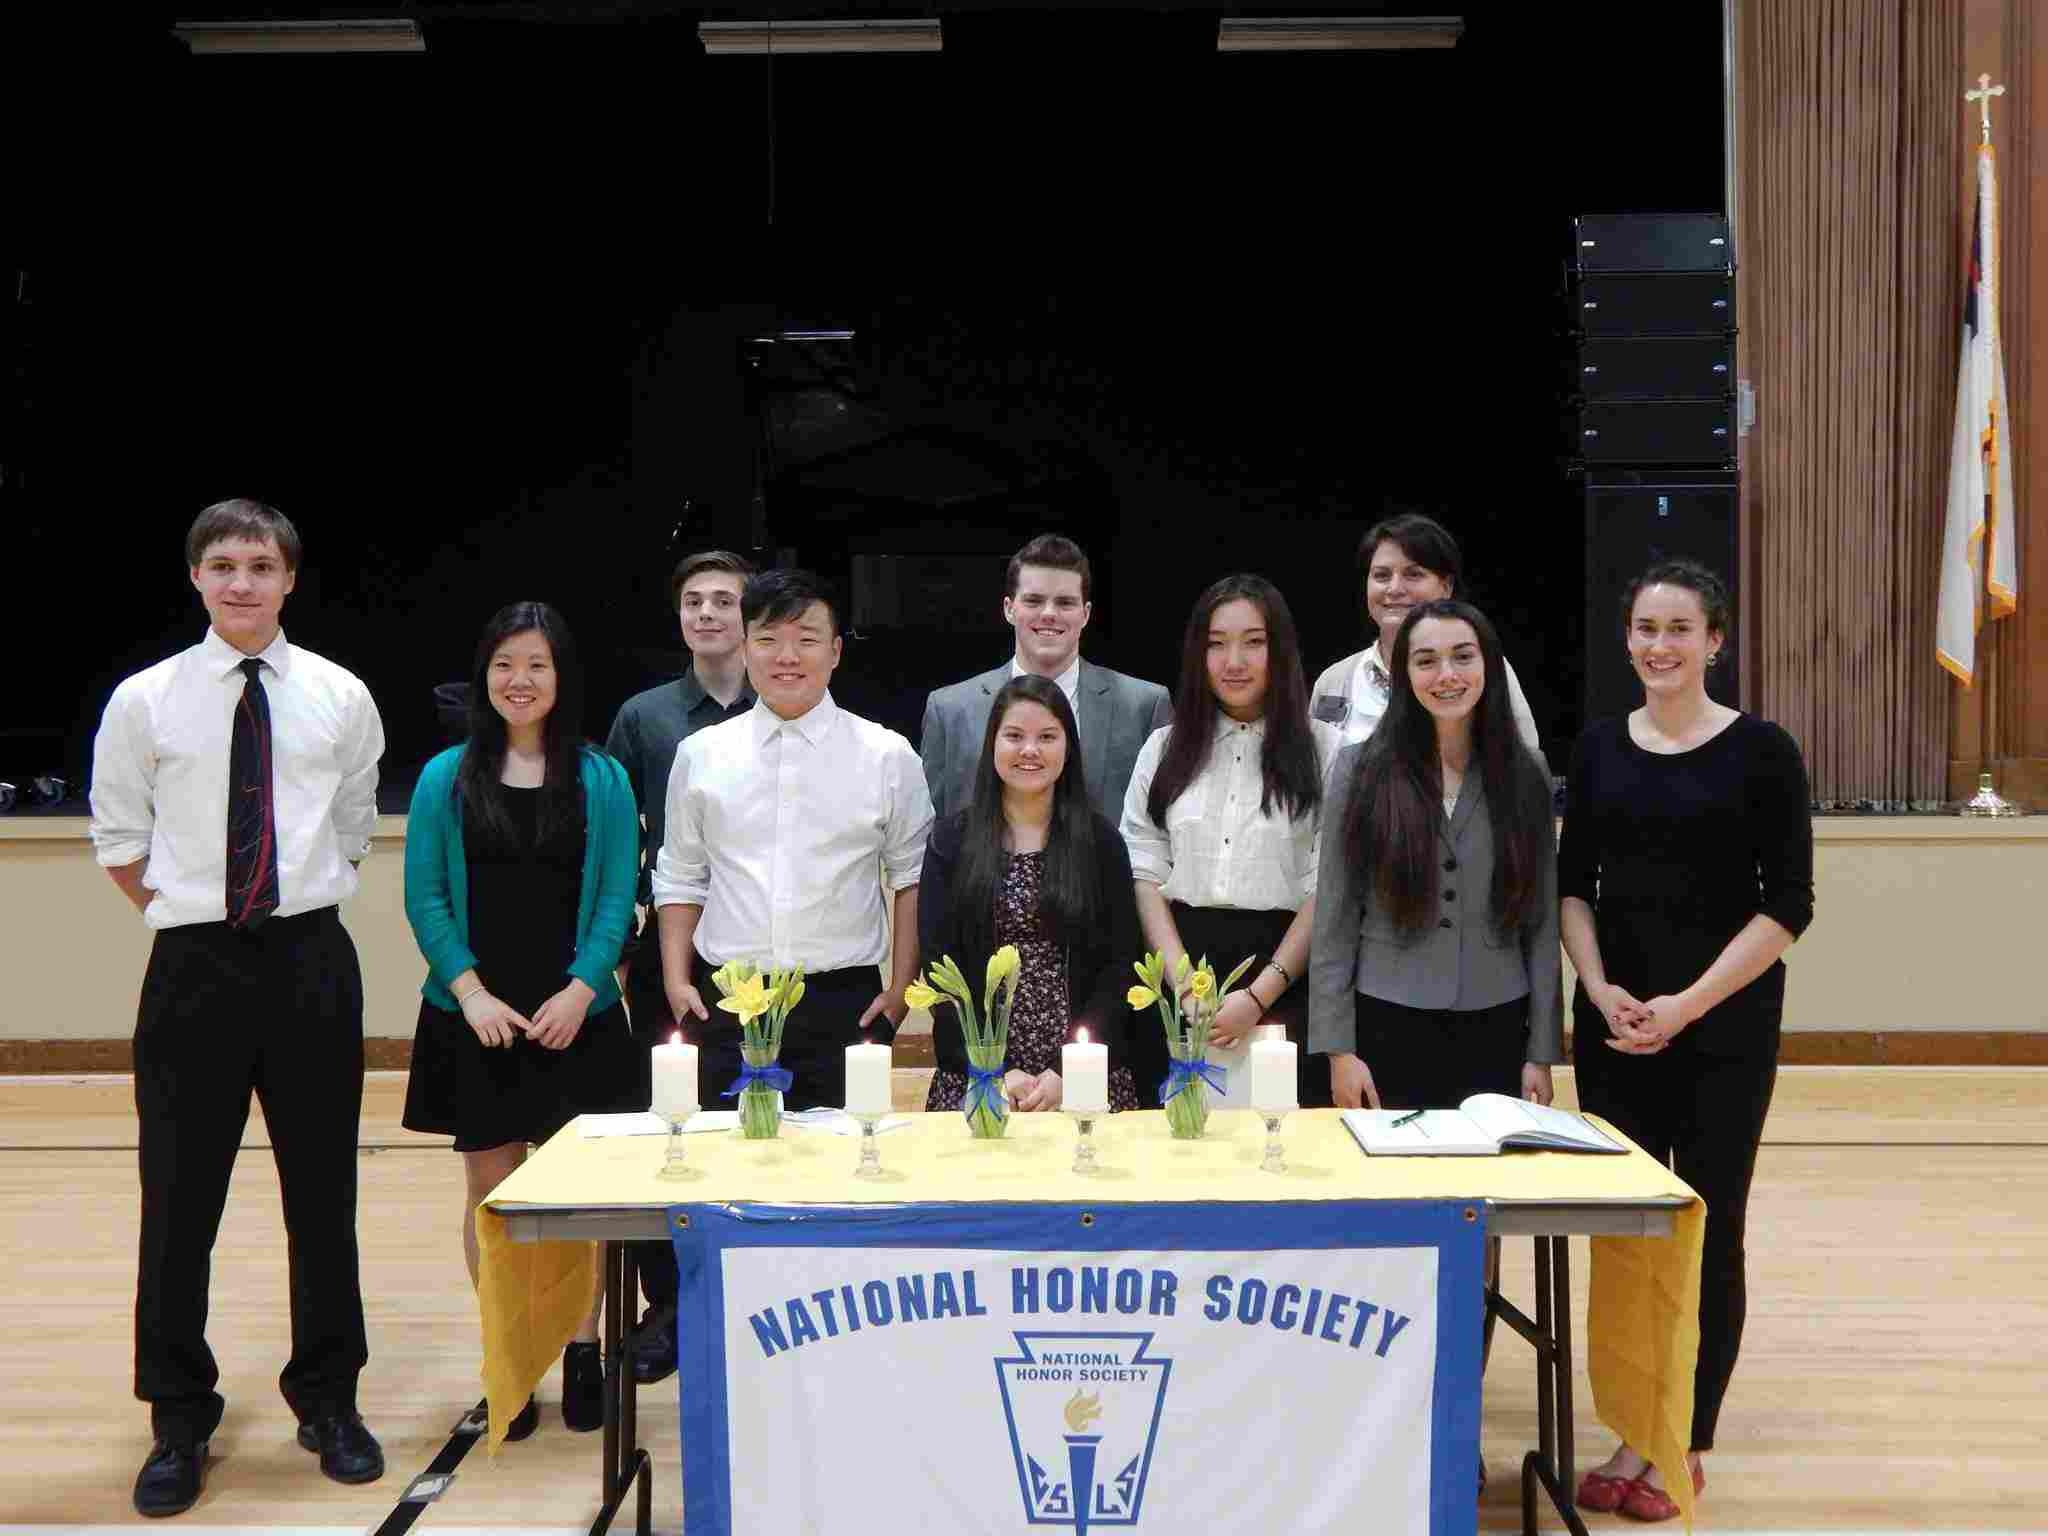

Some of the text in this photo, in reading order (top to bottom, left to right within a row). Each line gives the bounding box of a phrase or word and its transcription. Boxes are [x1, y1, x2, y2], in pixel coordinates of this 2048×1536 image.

[748, 1266, 1411, 1359] NATIONAL HONOR SOCIETY
[1042, 1353, 1122, 1365] NATIONAL
[1016, 1368, 1148, 1382] HONOR SOCIETY
